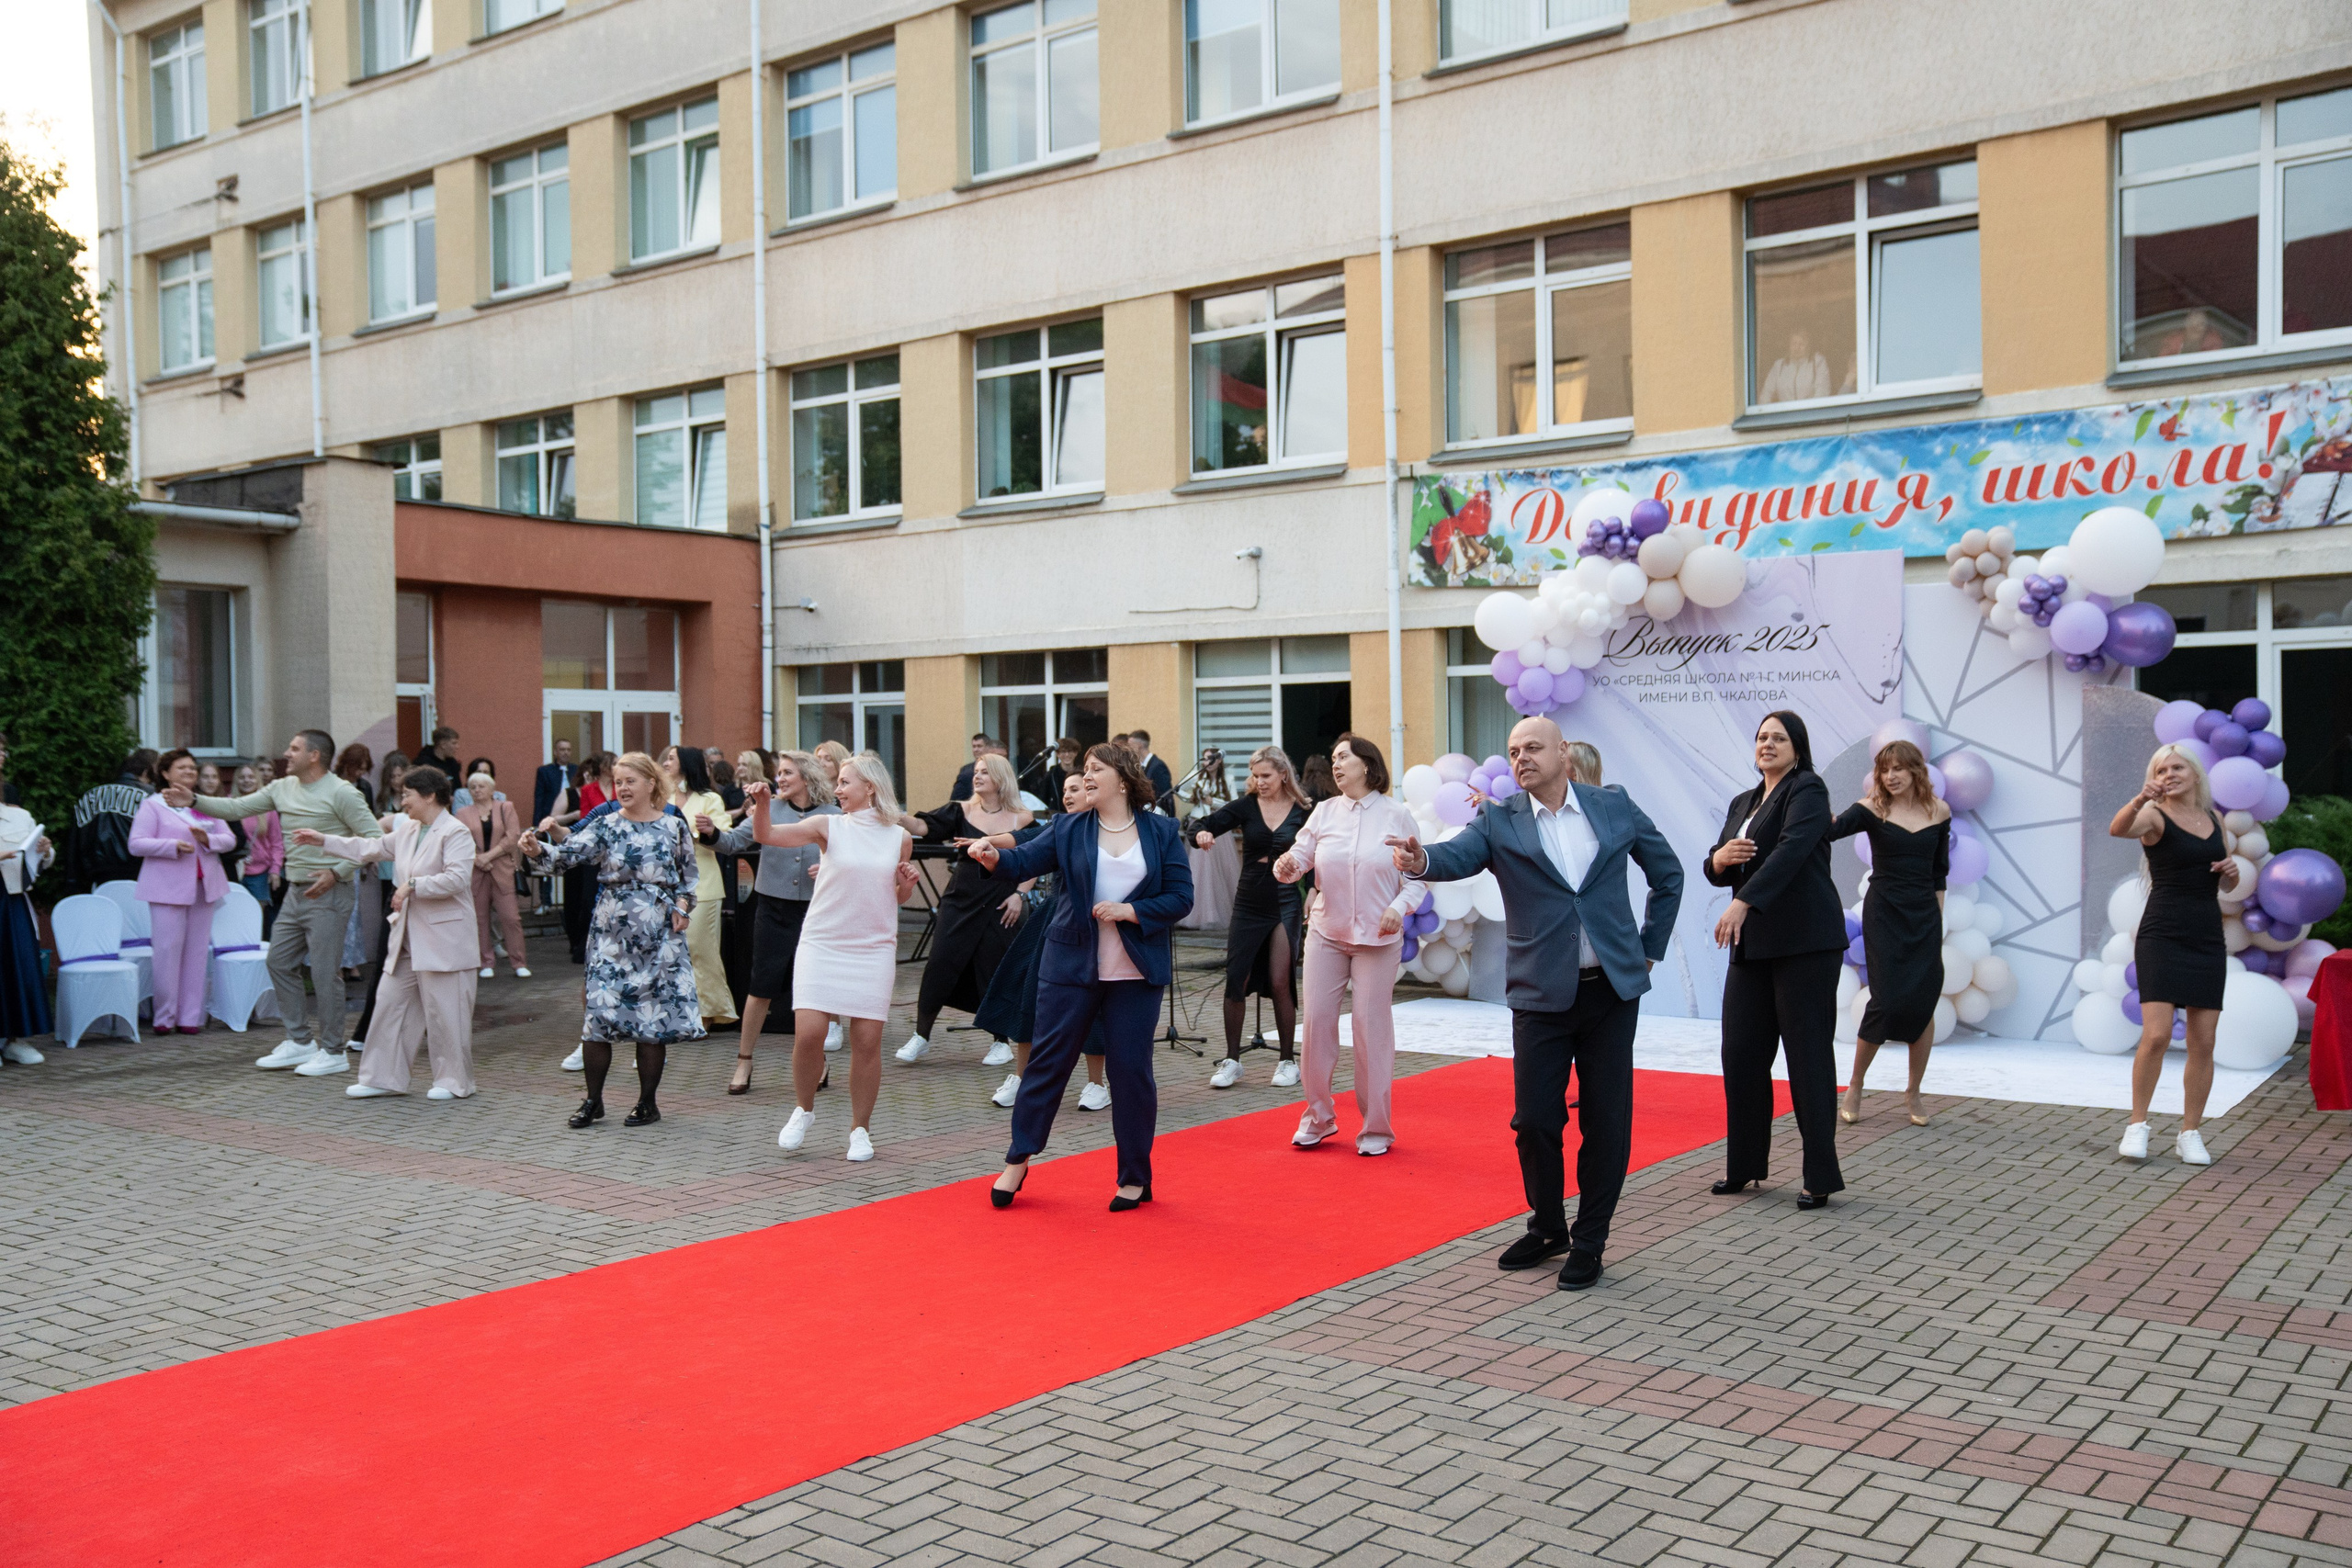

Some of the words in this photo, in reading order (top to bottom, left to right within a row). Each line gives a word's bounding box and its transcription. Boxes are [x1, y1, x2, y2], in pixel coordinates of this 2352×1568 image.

[1654, 470, 1954, 551] видания,
[1982, 410, 2287, 504] школа!
[1601, 615, 1742, 671] Выпуск
[1742, 624, 1831, 652] 2025
[1592, 675, 1611, 687] УО
[1613, 673, 1681, 687] «СРЕДНЯЯ
[1685, 672, 1736, 684] ШКОЛА
[1779, 670, 1841, 682] МИНСКА
[1639, 692, 1688, 703] ИМЕНИ
[1691, 691, 1716, 703] В.П.
[1719, 690, 1789, 702] ЧКАЛОВА
